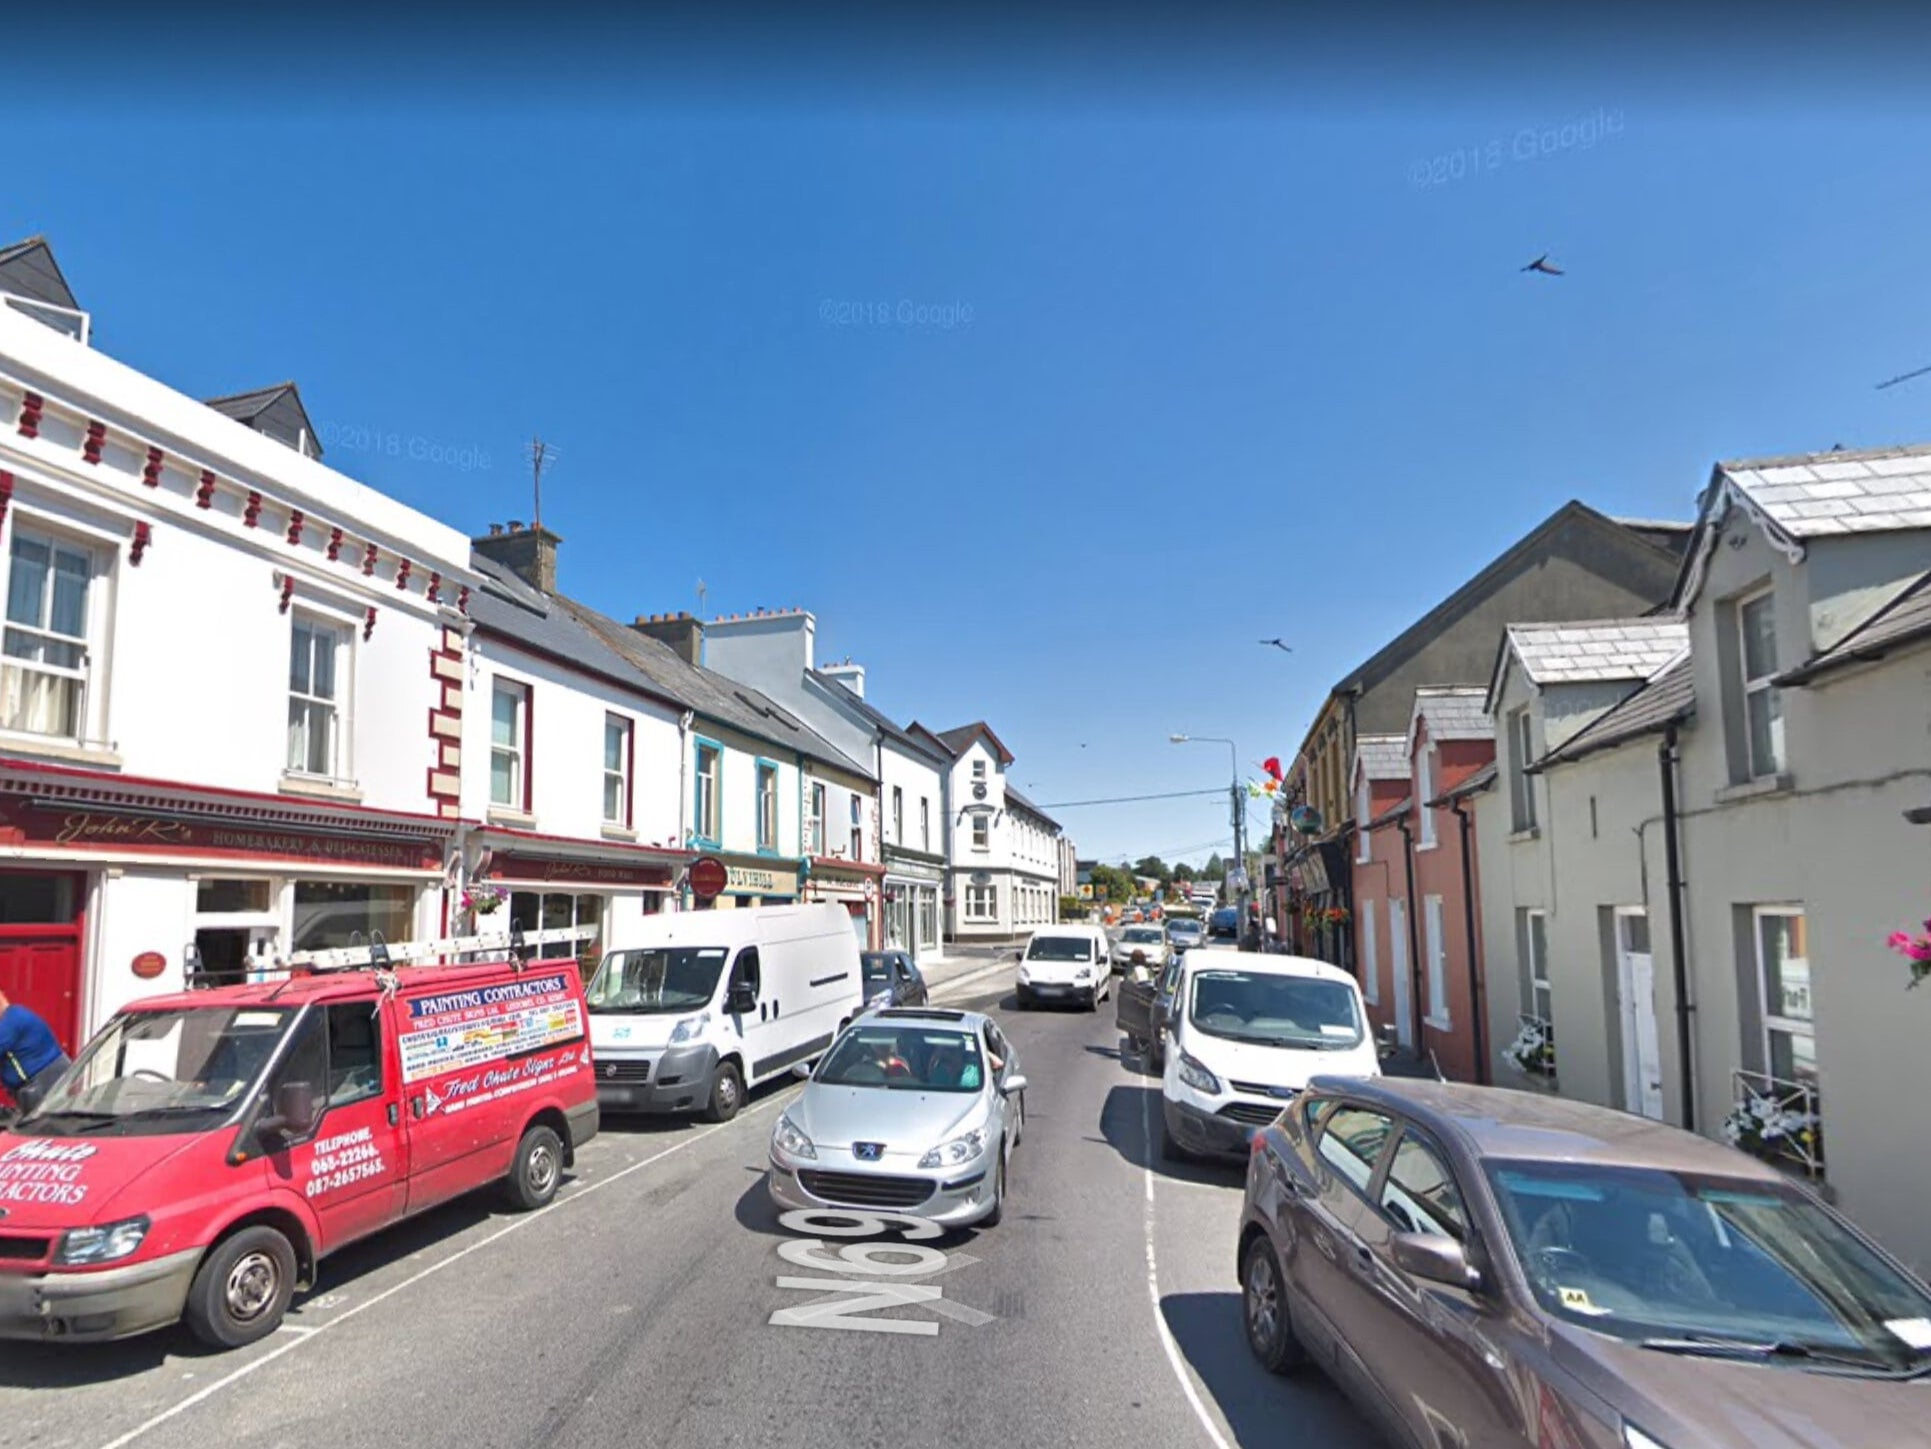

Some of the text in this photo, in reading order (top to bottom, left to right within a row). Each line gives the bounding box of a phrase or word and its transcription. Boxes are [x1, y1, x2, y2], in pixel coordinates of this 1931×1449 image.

[56, 813, 133, 845] John
[212, 831, 302, 850] HOMEBAKERY
[420, 977, 562, 1015] PAINTING CONTRACTORS
[443, 1074, 480, 1100] Fred
[483, 1066, 520, 1089] Chute
[522, 1056, 555, 1077] Signs
[0, 1161, 83, 1183] INTING
[768, 1207, 949, 1337] N69
